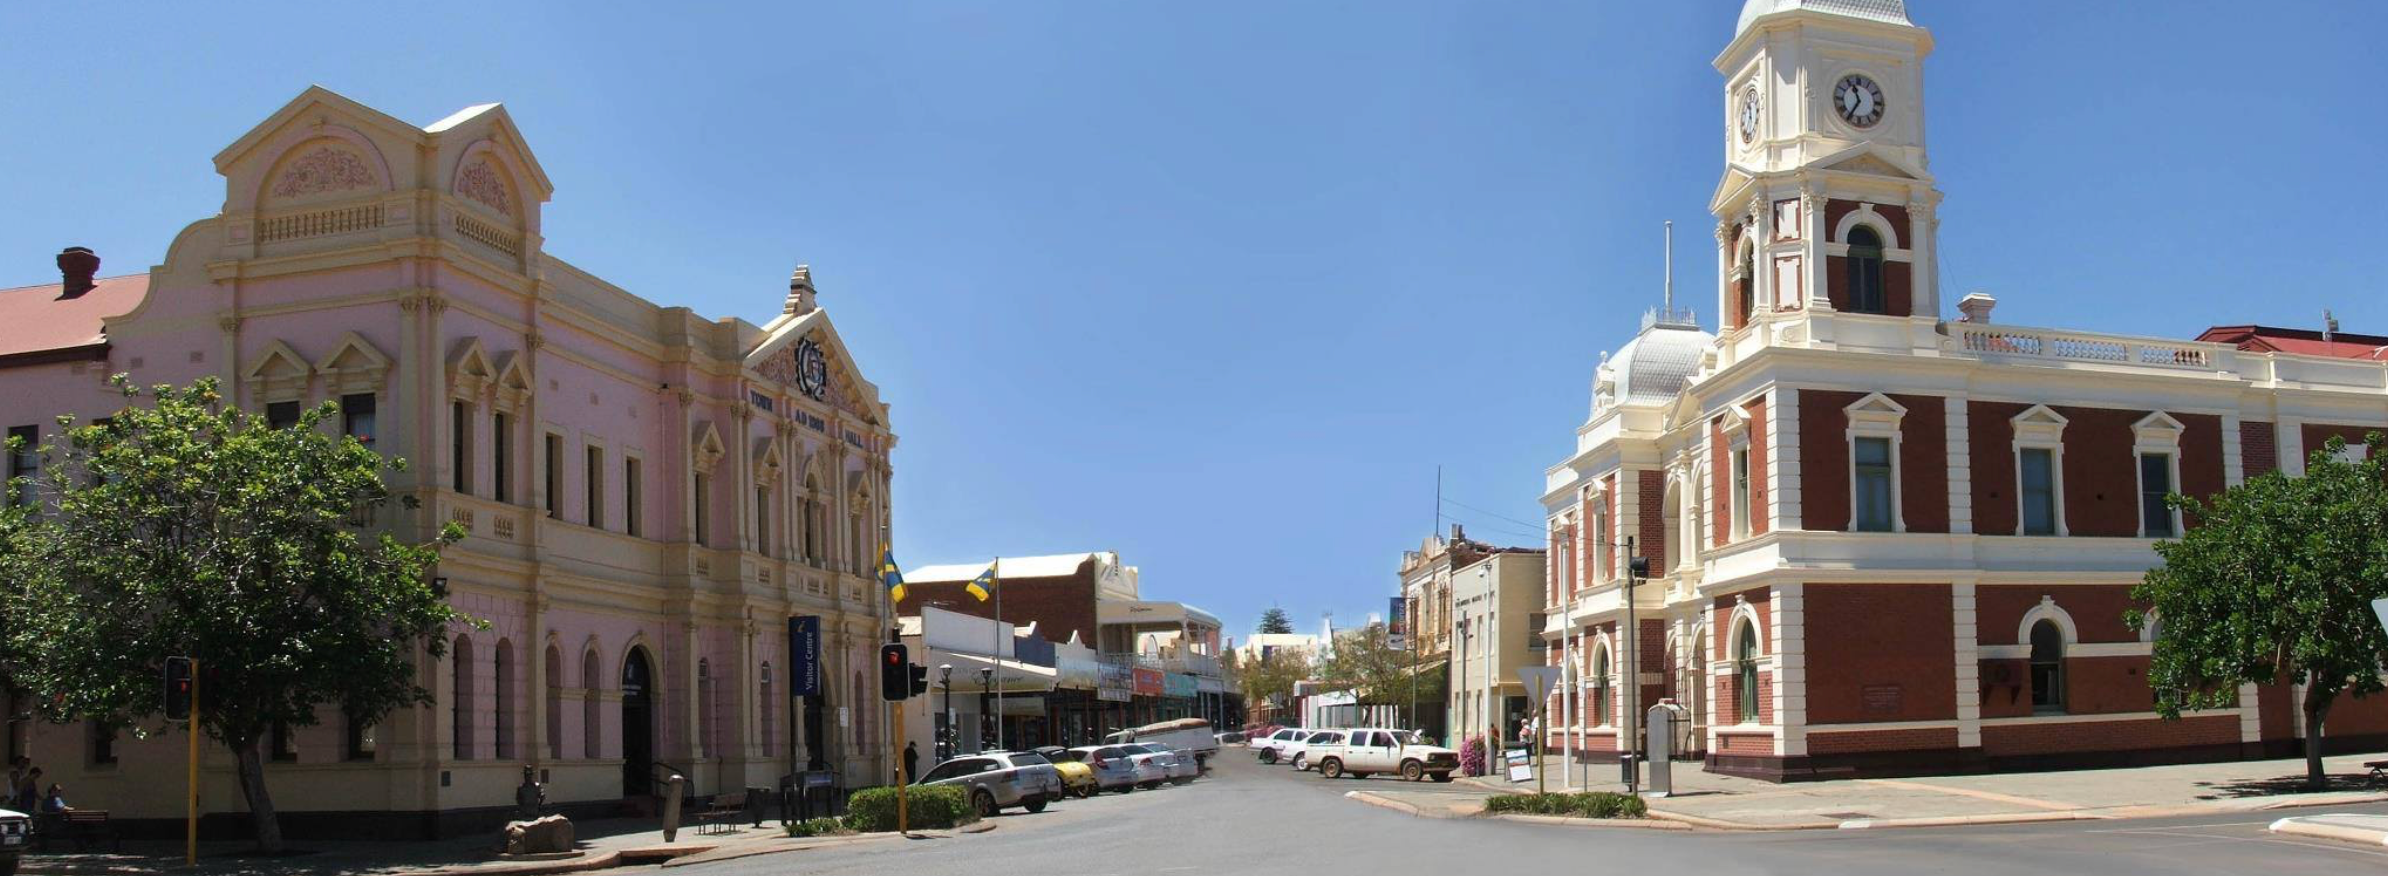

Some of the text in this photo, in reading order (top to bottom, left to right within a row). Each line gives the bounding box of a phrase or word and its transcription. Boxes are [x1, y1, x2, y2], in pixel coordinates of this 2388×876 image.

[750, 389, 773, 413] TOWN
[845, 429, 863, 449] HALL
[805, 631, 814, 691] Visitor Centre
